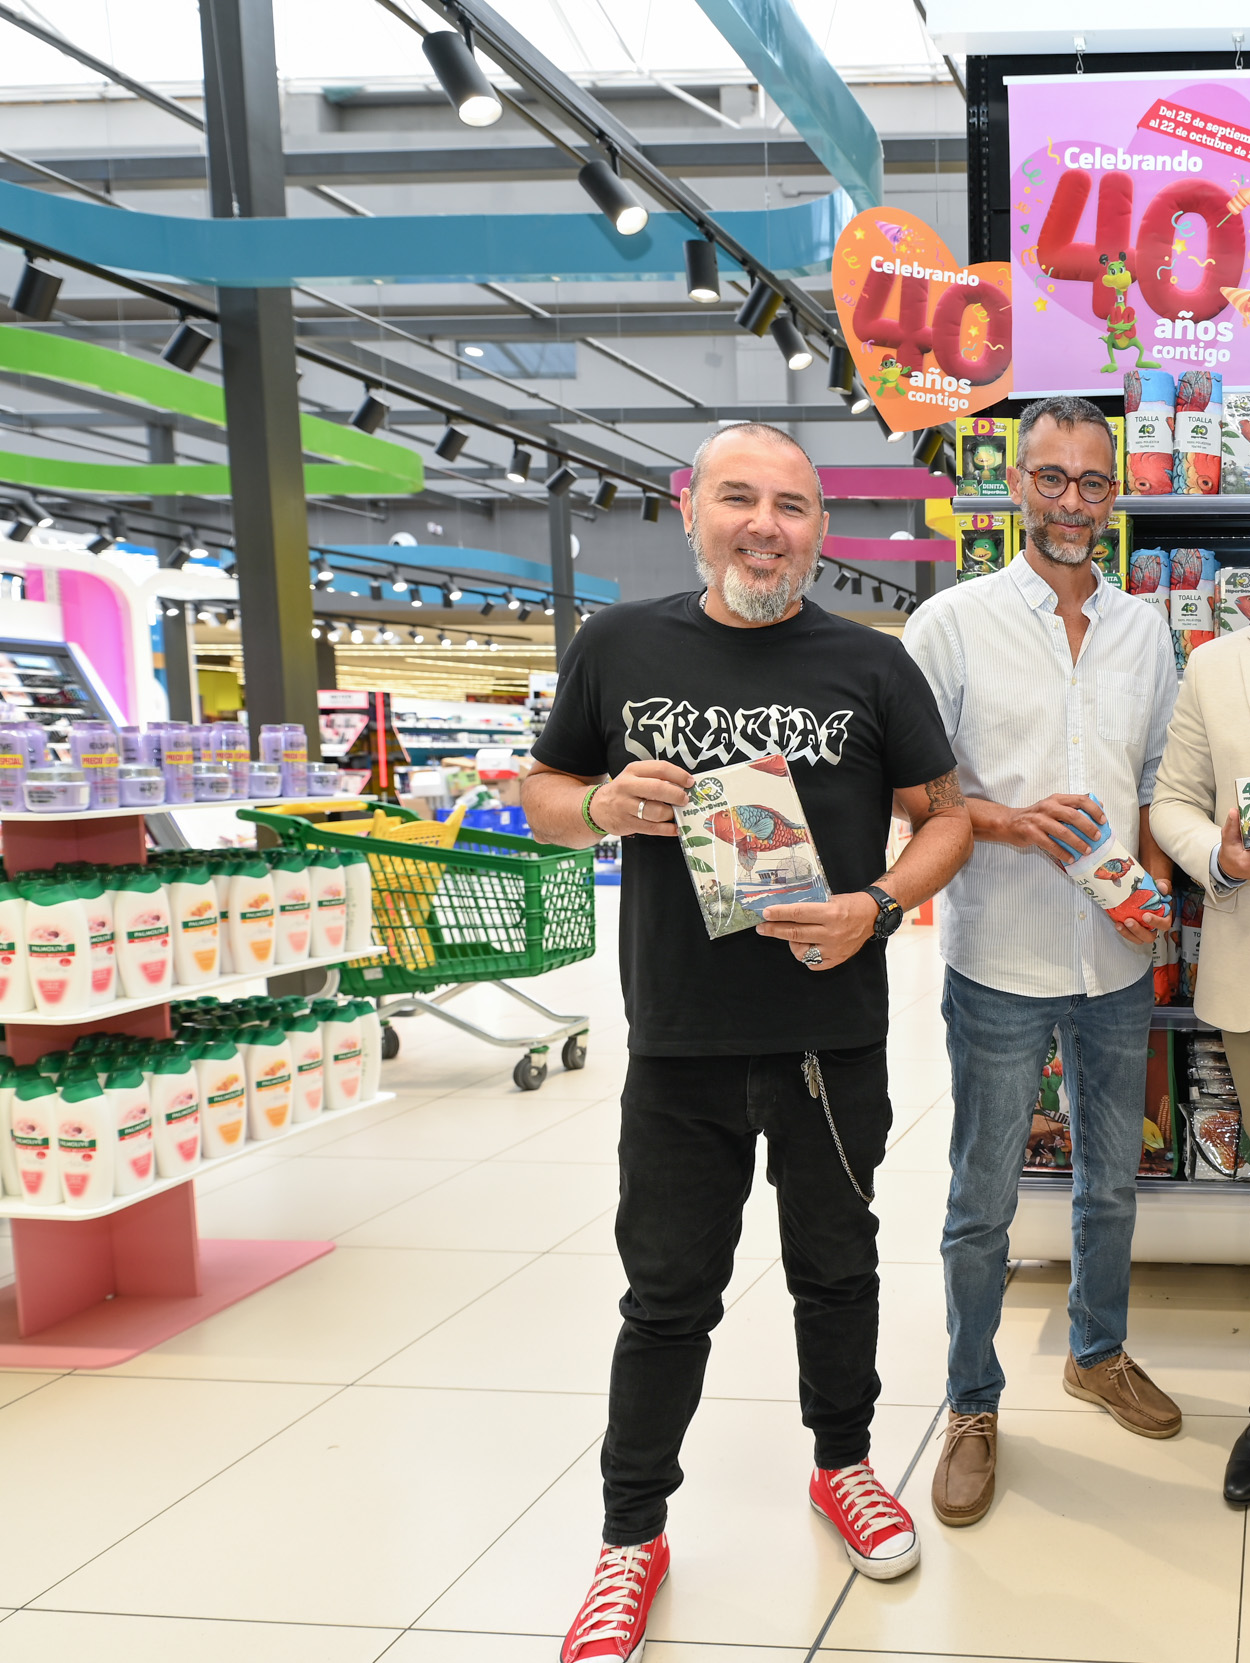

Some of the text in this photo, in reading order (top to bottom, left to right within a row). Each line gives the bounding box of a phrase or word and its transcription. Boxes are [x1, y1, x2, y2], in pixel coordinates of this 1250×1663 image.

[1159, 106, 1176, 119] Del
[1176, 111, 1192, 124] 25
[1192, 118, 1205, 128] de
[1149, 119, 1159, 128] al
[1160, 120, 1175, 133] 22
[1175, 127, 1188, 137] de
[1189, 132, 1233, 152] octubre
[1234, 146, 1246, 157] de
[1064, 147, 1203, 173] Celebrando
[1036, 168, 1245, 320] 40
[870, 255, 980, 287] Celebrando
[853, 262, 1012, 387] 40
[1154, 310, 1234, 342] años
[1152, 342, 1231, 368] contigo
[909, 367, 972, 395] años
[907, 389, 969, 412] contigo
[977, 419, 991, 434] D
[1188, 416, 1213, 424] TOALLA
